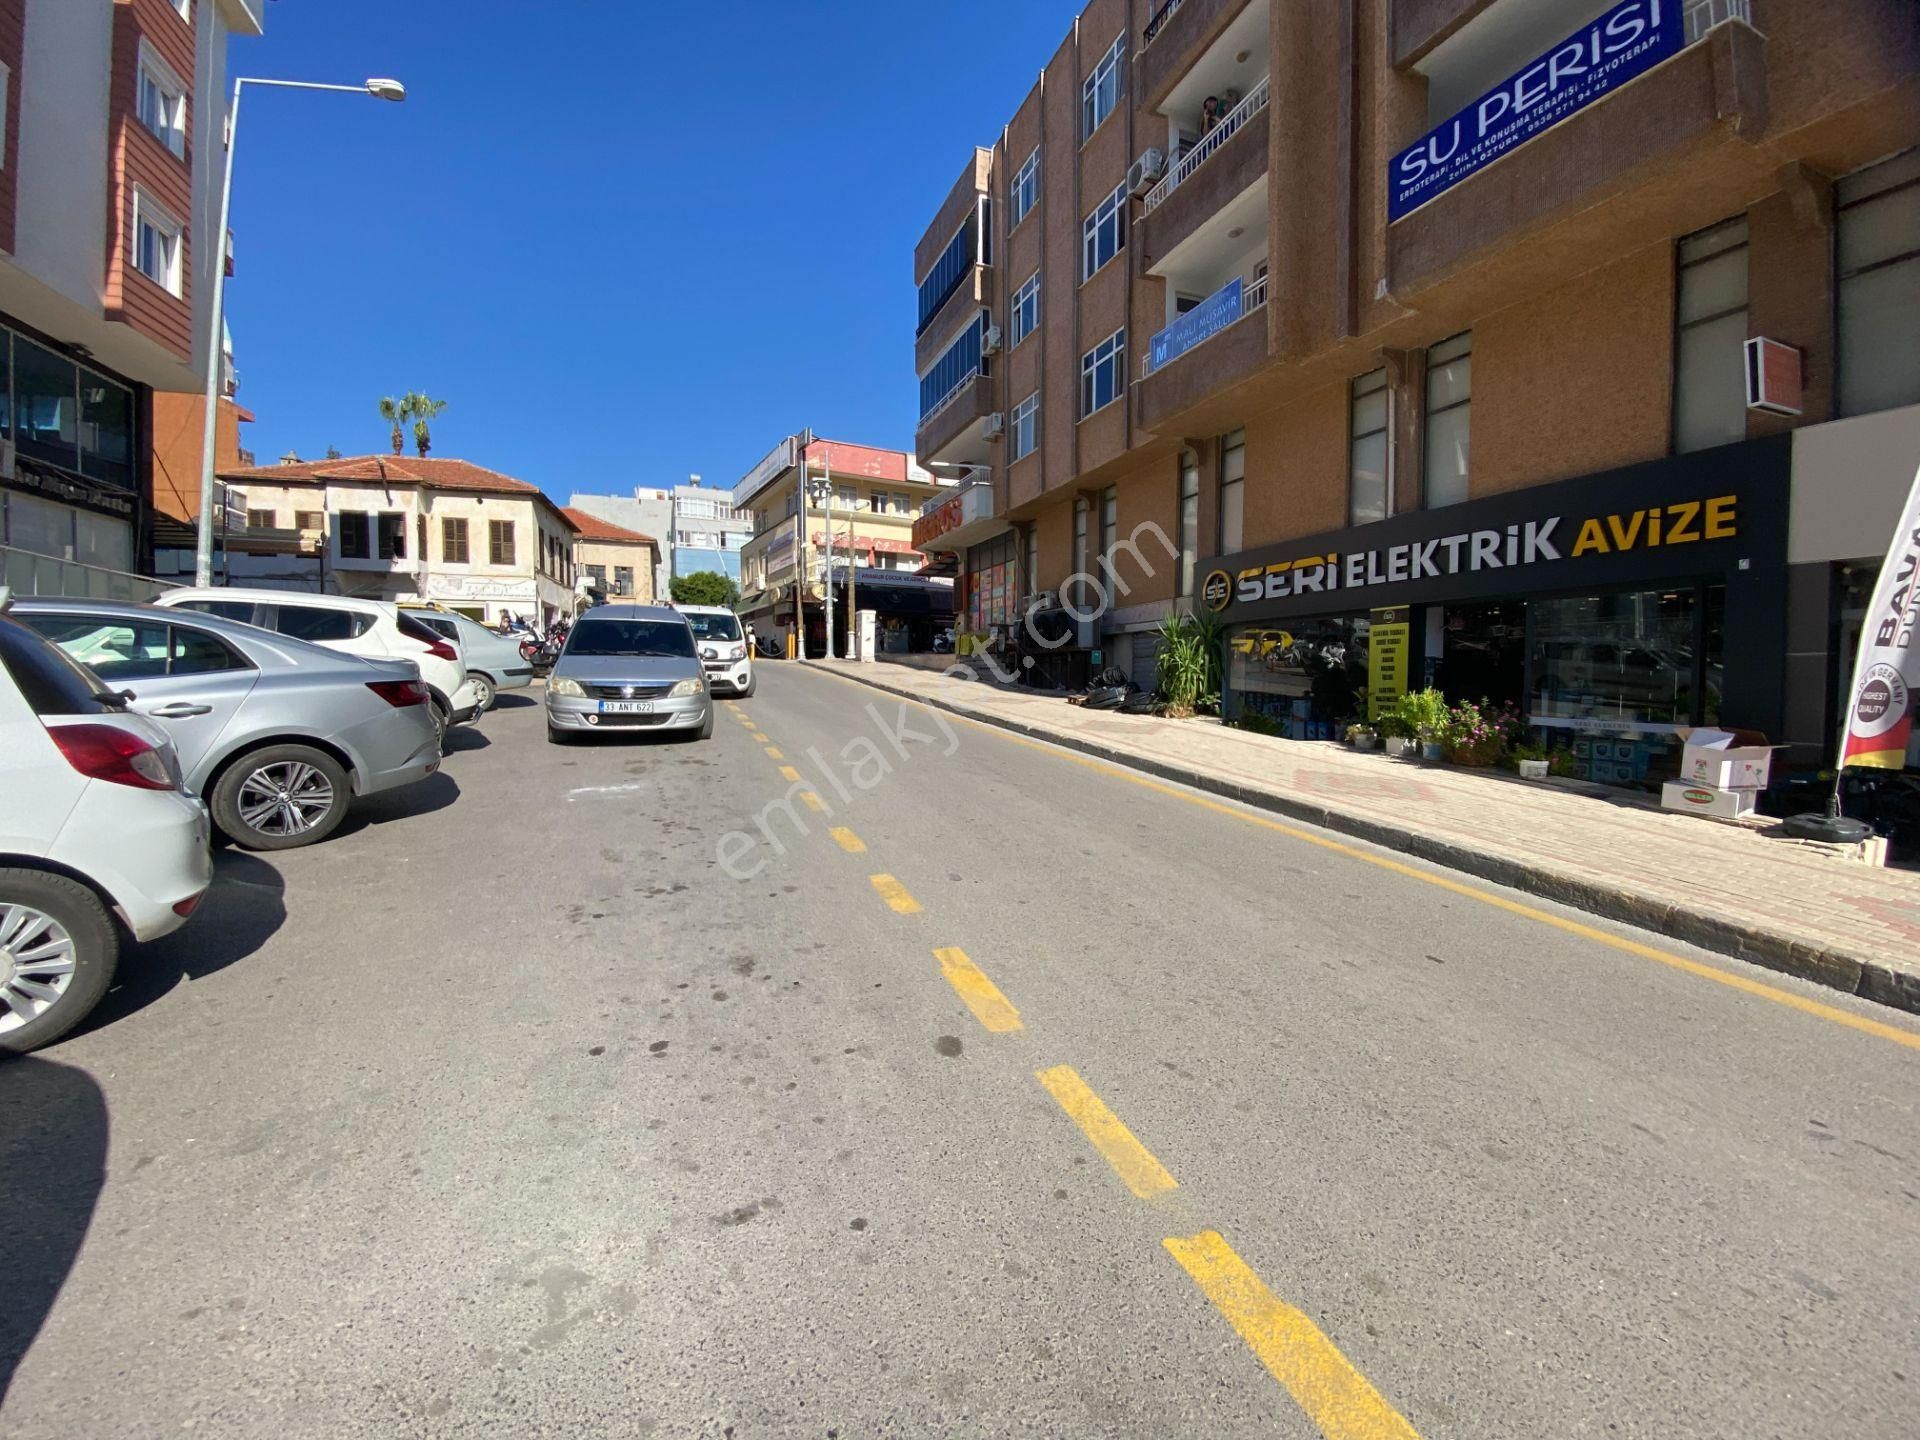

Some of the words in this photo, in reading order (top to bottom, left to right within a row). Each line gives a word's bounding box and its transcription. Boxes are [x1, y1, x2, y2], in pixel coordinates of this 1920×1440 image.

[1400, 120, 1460, 185] SU
[1471, 143, 1482, 156] VE
[1345, 516, 1563, 588] ELEKTRİK
[1570, 494, 1737, 558] AVİZE
[1877, 667, 1903, 705] GERMANY
[605, 703, 615, 711] 33
[618, 703, 633, 711] ANT
[636, 703, 651, 711] 622
[1858, 704, 1885, 714] QUALITY
